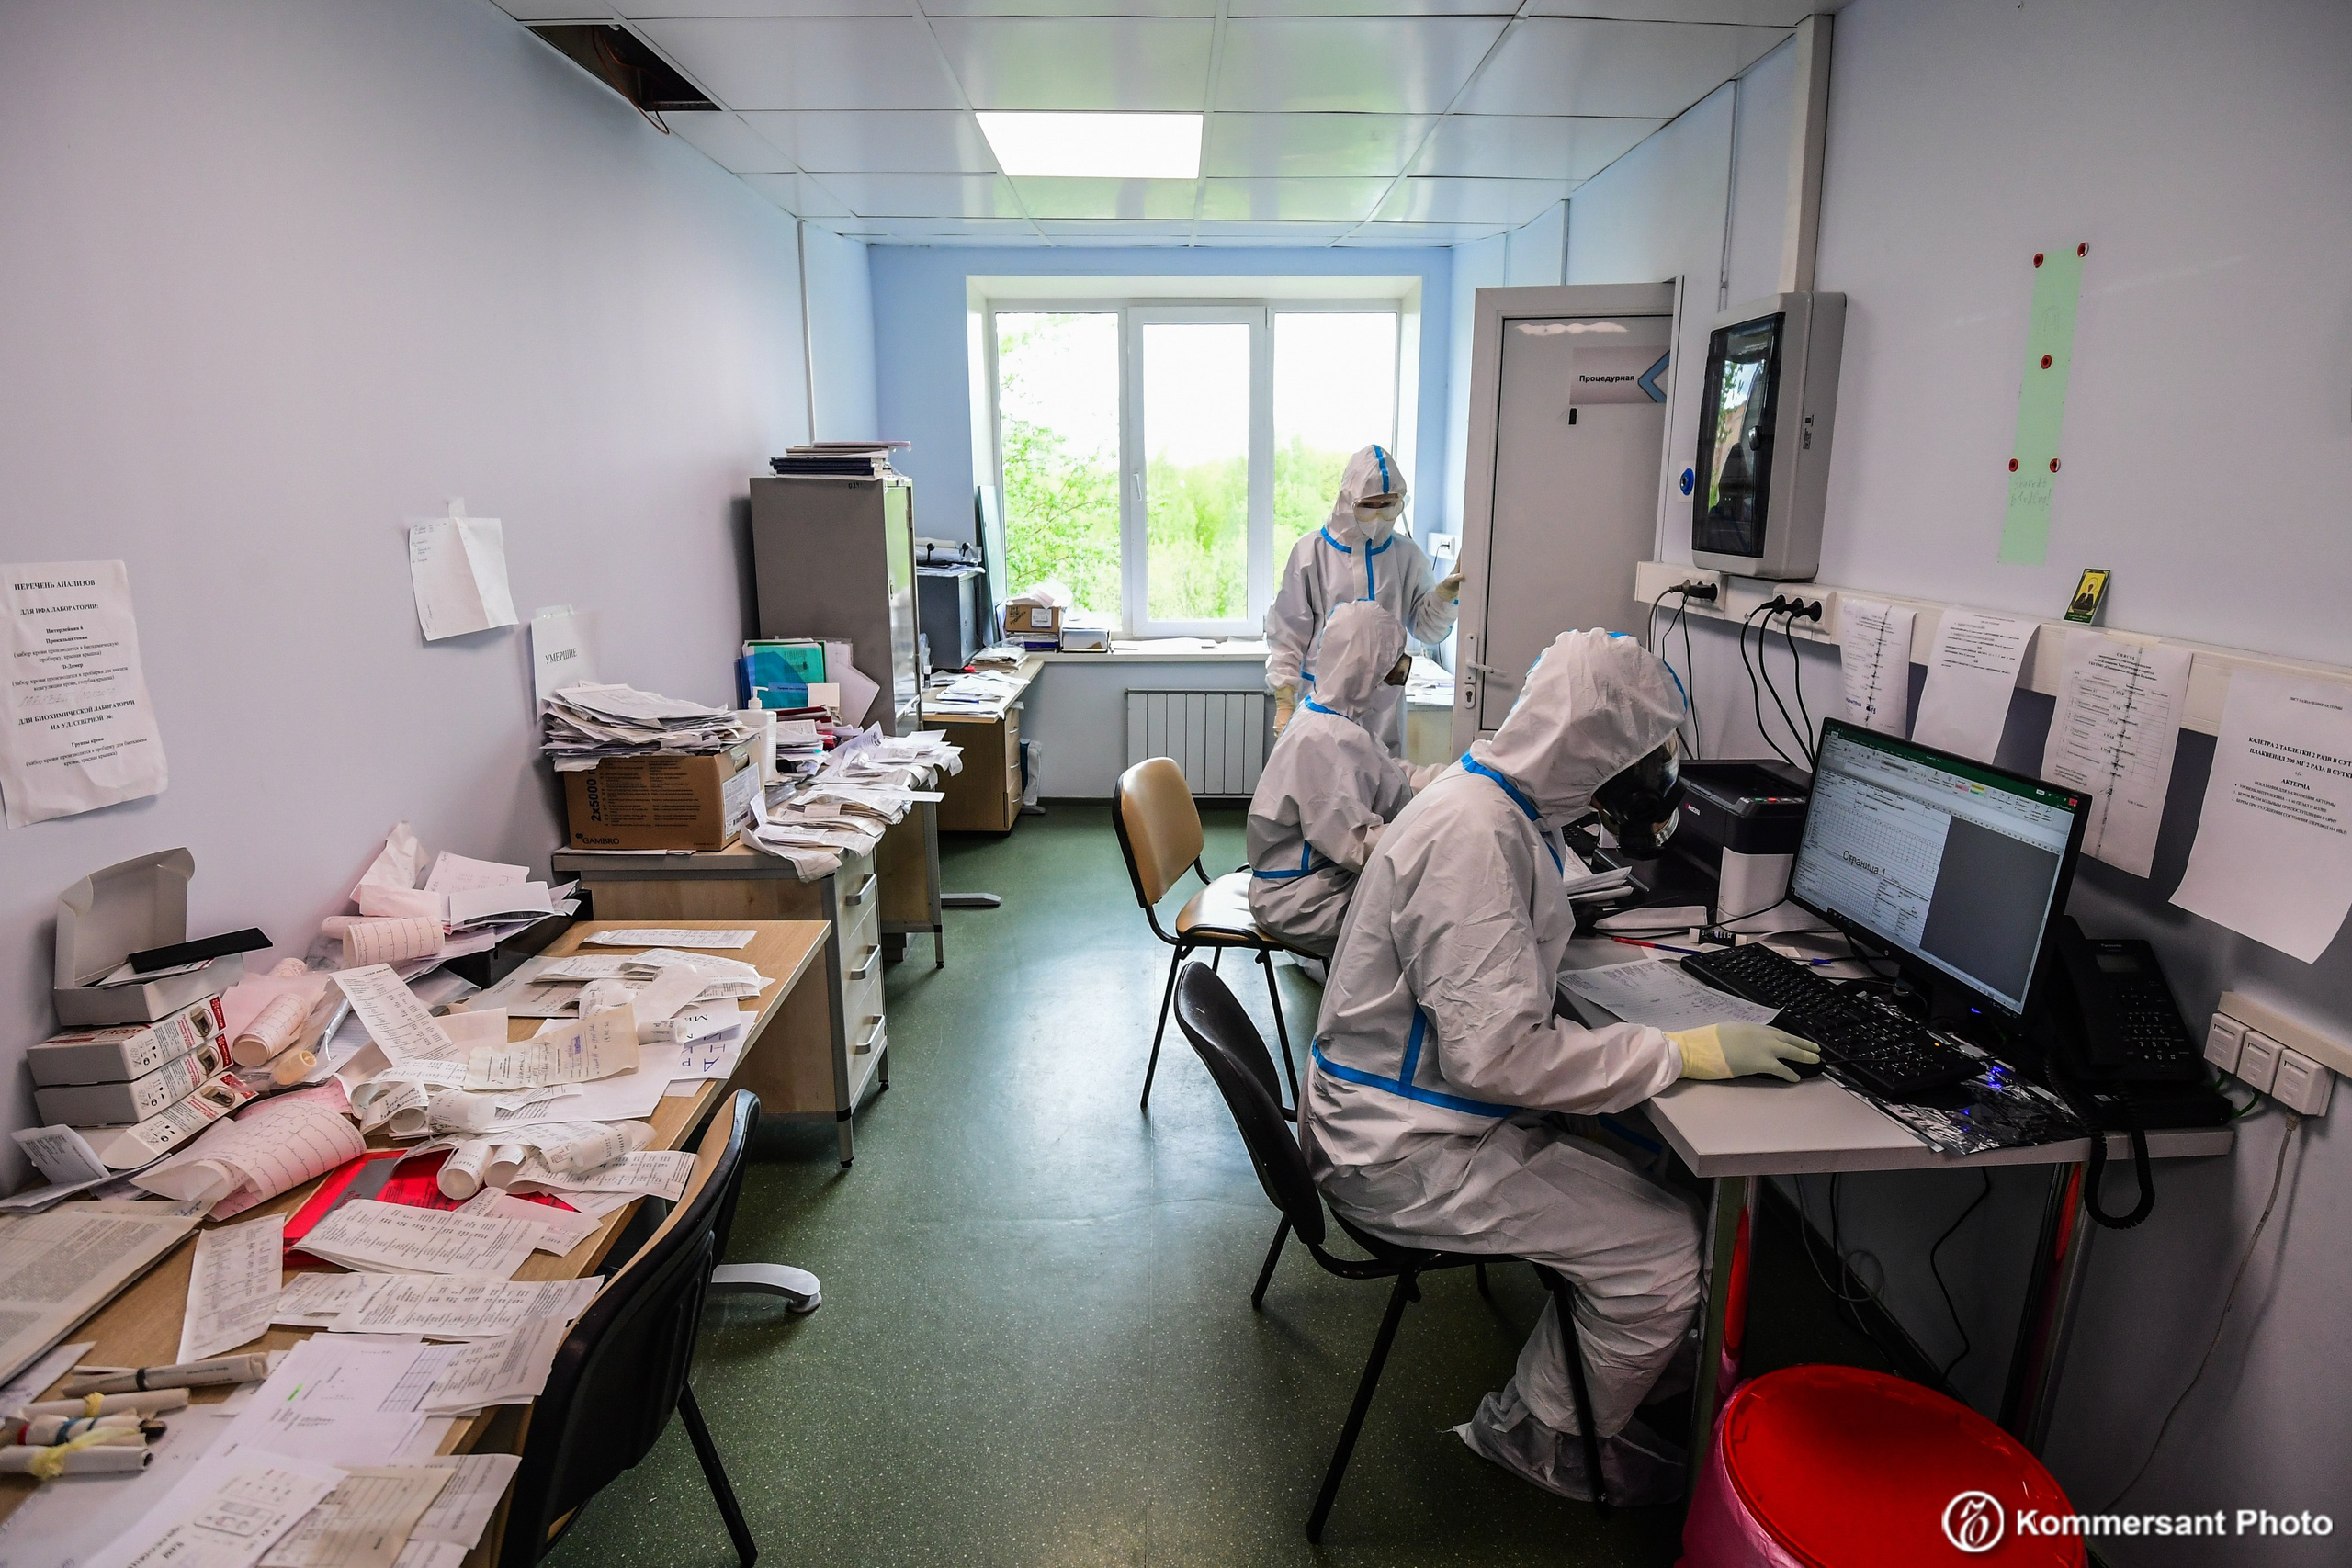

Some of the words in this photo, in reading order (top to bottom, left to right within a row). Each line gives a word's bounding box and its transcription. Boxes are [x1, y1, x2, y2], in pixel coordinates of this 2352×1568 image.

[1579, 375, 1635, 384] Процедурная
[56, 580, 96, 588] АНАЛИЗОВ
[51, 604, 99, 613] ЛАБОРАТОРИИ:
[545, 648, 578, 664] УМЕРШИЕ
[18, 717, 33, 726] ДЛЯ
[34, 706, 93, 723] БИОХИМИЧЕСКОЙ
[94, 699, 135, 712] ЛАБОРАТОРИИ
[74, 715, 104, 727] СЕВЕРНОЙ
[2248, 737, 2274, 748] КАЛЕТРА
[2279, 745, 2311, 757] ТАБЛЕТКИ
[2249, 748, 2286, 761] ПЛАКВЕНИЛ
[2310, 763, 2325, 772] РАЗА
[2281, 778, 2310, 790] АКТЕРМА
[582, 837, 620, 845] GAMBRO
[1842, 849, 1880, 876] Страница
[1882, 868, 1886, 878] 1
